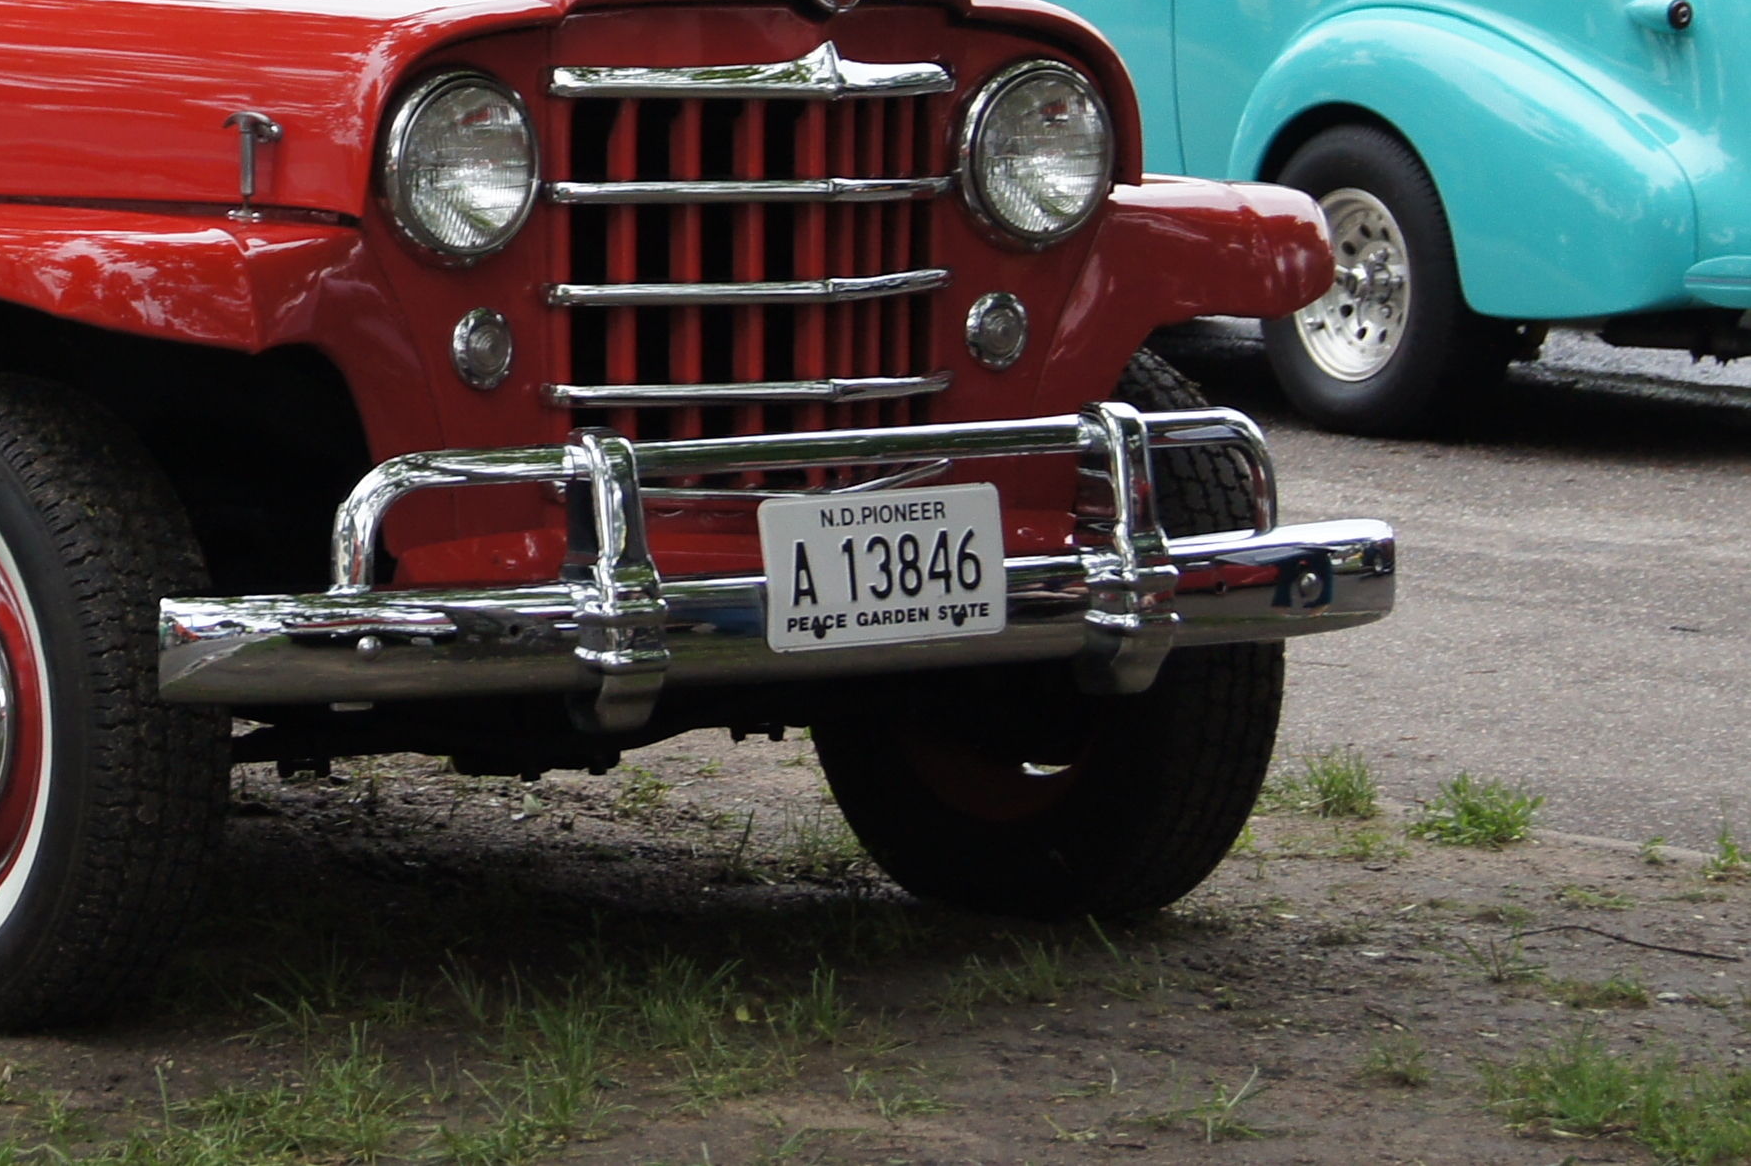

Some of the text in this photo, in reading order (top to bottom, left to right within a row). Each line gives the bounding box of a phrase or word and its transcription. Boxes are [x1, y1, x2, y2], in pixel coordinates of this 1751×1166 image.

[793, 527, 982, 607] A 13846
[787, 602, 990, 634] PEACE GARDEN STATE
